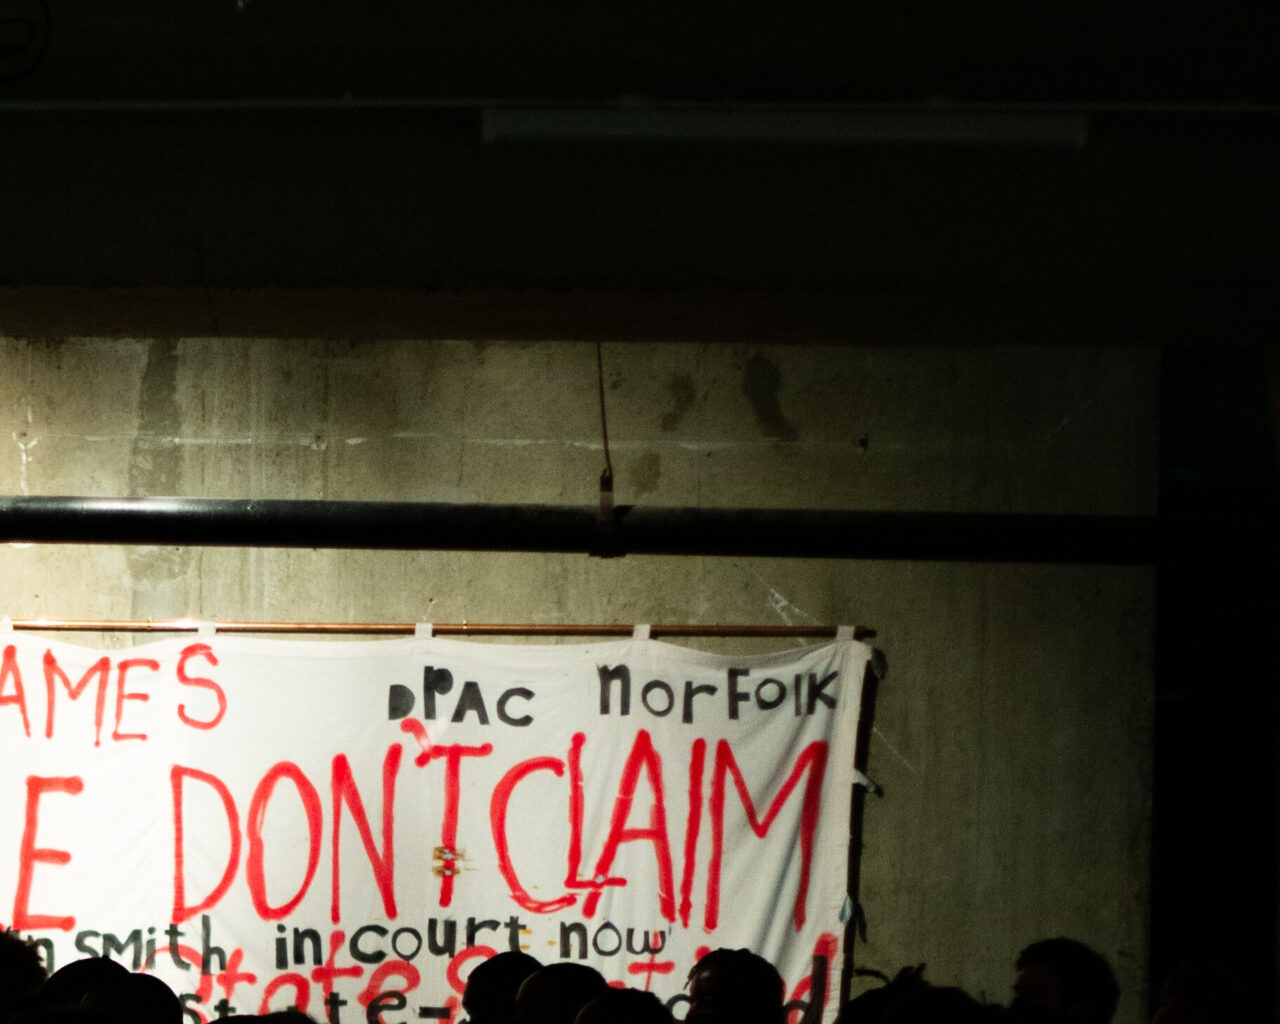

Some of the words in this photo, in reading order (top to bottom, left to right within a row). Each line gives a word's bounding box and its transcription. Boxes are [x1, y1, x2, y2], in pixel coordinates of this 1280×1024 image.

[275, 924, 323, 970] in
[349, 915, 527, 967] court
[560, 920, 666, 960] now
